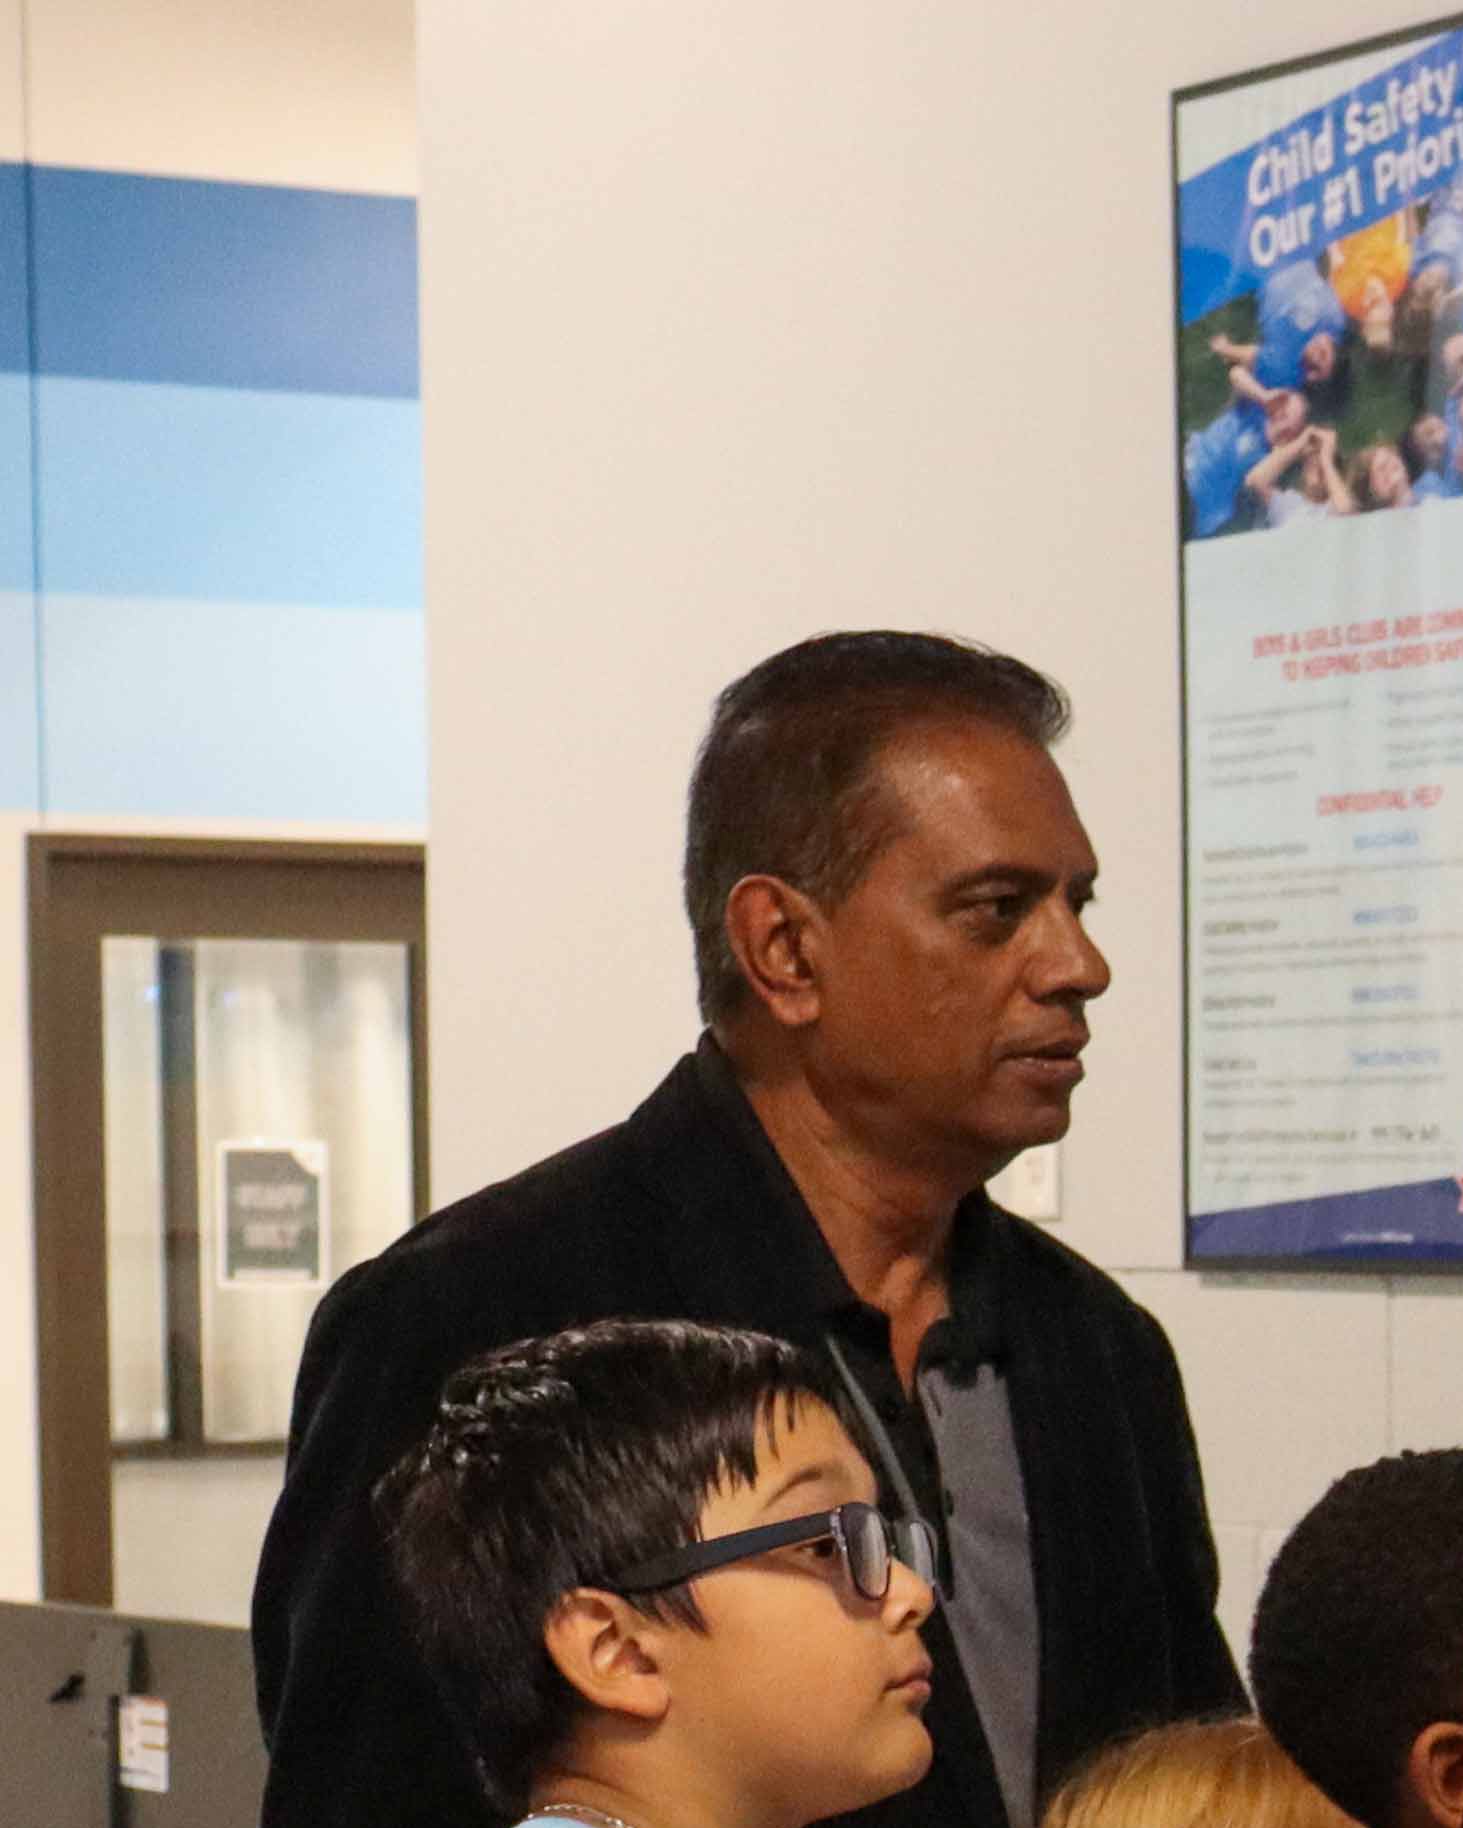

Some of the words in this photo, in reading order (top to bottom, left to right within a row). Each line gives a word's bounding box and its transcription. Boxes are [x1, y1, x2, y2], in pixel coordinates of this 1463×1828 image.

[1249, 112, 1335, 207] Child
[1343, 60, 1457, 156] Safety
[1250, 202, 1317, 268] Our
[1322, 165, 1364, 231] #1
